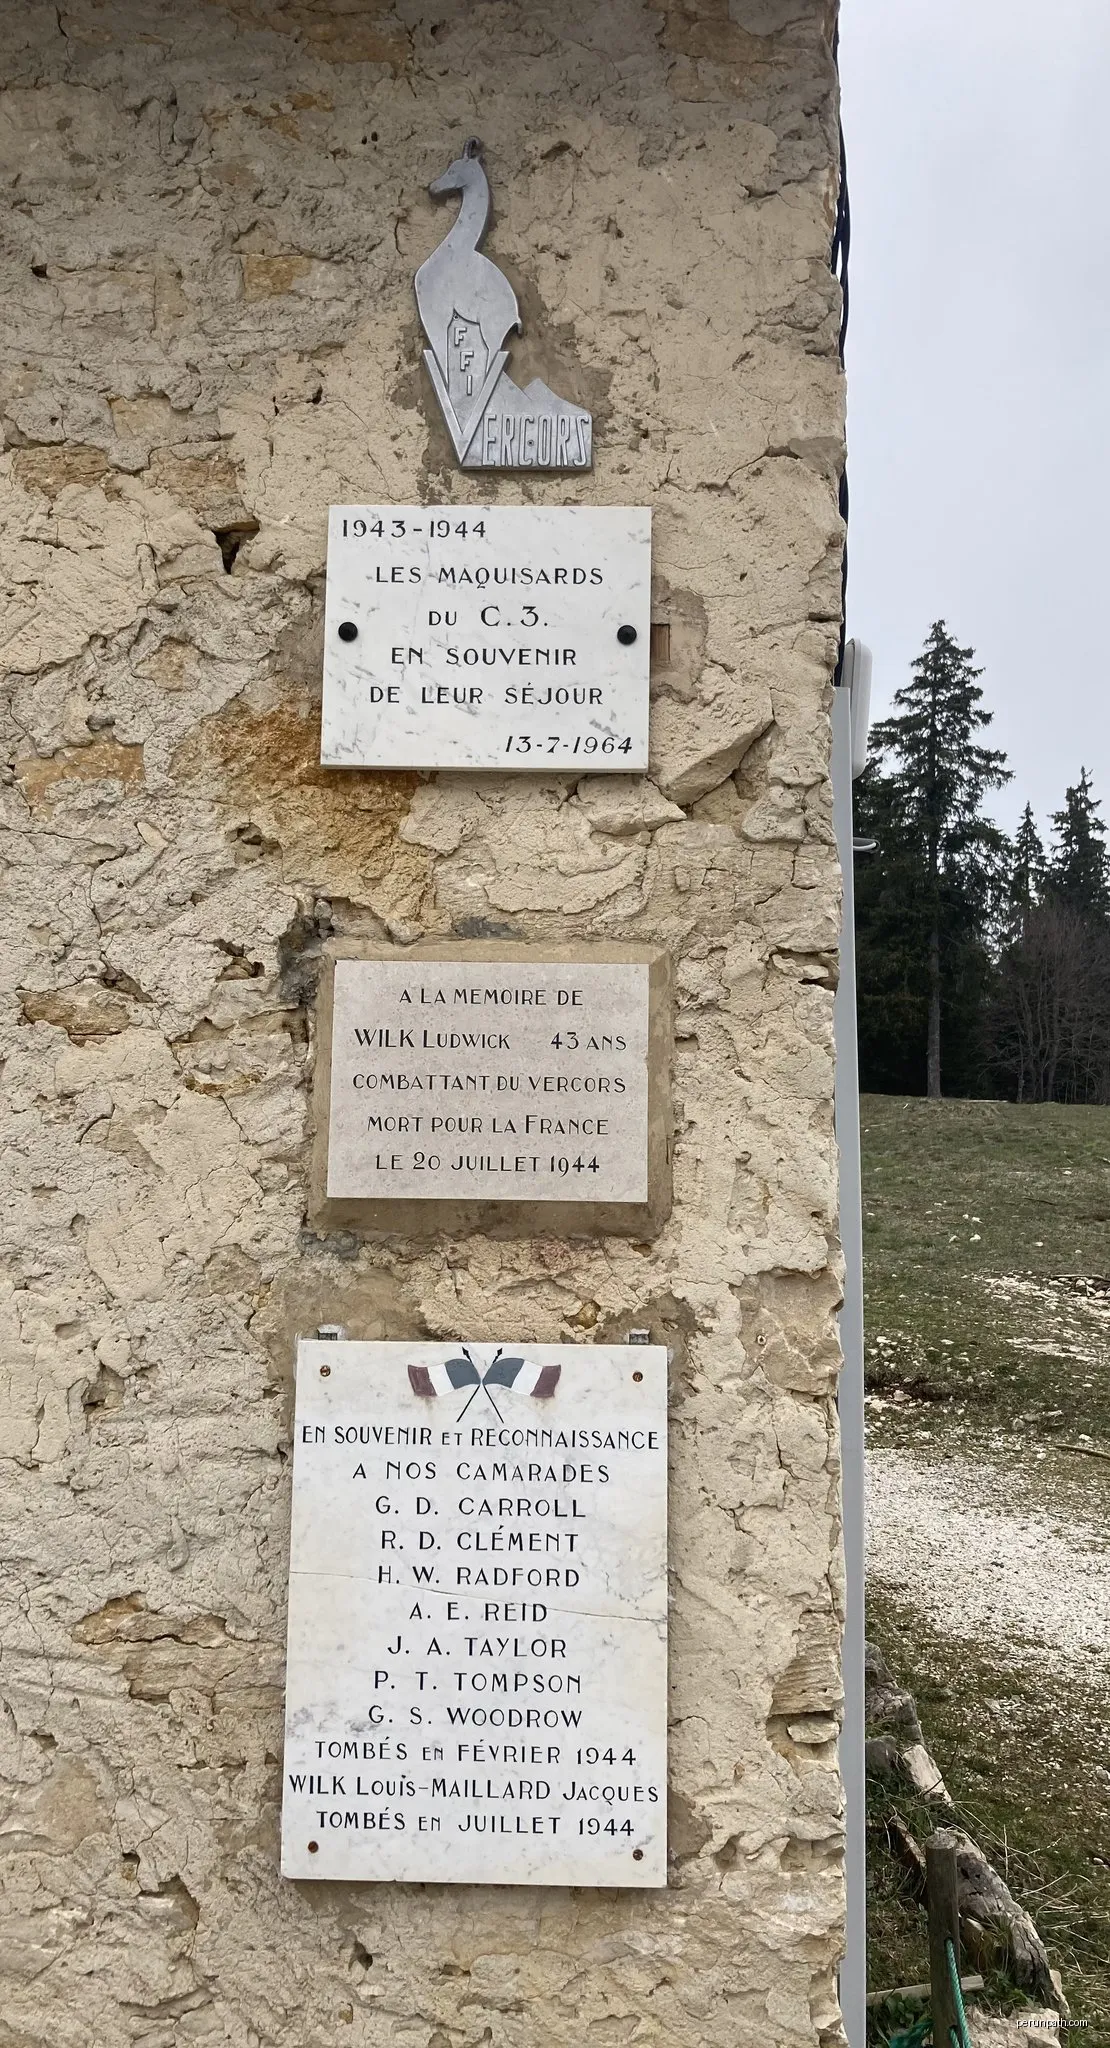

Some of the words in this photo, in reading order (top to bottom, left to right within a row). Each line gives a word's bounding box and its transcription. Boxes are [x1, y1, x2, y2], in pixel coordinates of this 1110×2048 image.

[342, 519, 487, 538] 1943-1944
[376, 566, 422, 583] LES
[438, 567, 604, 588] MAQUISARDS
[428, 610, 457, 626] DU
[391, 648, 423, 664] EN
[446, 648, 577, 665] SOUVENIR
[370, 686, 400, 703] DE
[421, 687, 483, 704] LEUR
[504, 682, 603, 705] SÉJOUR
[505, 736, 632, 754] 13-7-1964
[399, 989, 412, 1004] A
[420, 988, 446, 1004] LA
[453, 989, 546, 1006] MEMOIRE
[557, 990, 583, 1006] DE
[354, 1029, 415, 1048] WILK
[550, 1032, 579, 1050] 43
[586, 1034, 627, 1051] ANS
[352, 1074, 490, 1091] COMBATTANT
[497, 1076, 520, 1091] DU
[528, 1076, 626, 1093] VERCORS
[367, 1116, 423, 1133] MORT
[431, 1117, 482, 1133] POUR
[492, 1118, 516, 1133] LA
[376, 1154, 403, 1170] LE
[412, 1152, 441, 1171] 20
[451, 1155, 541, 1172] JUILLET
[550, 1155, 600, 1177] 1944
[302, 1425, 326, 1444] EN
[334, 1426, 432, 1446] SOUVENIR
[470, 1428, 659, 1450] RECONNAISSANCE
[352, 1463, 366, 1479] A
[386, 1462, 437, 1480] NOS
[456, 1462, 609, 1484] CAMARADES
[375, 1496, 399, 1514] G.
[416, 1497, 439, 1516] D.
[458, 1497, 586, 1518] CARROLL
[381, 1530, 403, 1550] R.
[419, 1531, 441, 1550] D.
[457, 1525, 579, 1552] CLÉMENT
[378, 1566, 400, 1584] H.
[412, 1567, 440, 1584] W.
[456, 1567, 580, 1587] RADFORD
[409, 1602, 431, 1620] A.
[447, 1602, 469, 1621] E.
[485, 1603, 548, 1622] REID
[387, 1636, 409, 1655] J.
[426, 1638, 450, 1656] A.
[464, 1638, 567, 1658] TAYLOR
[374, 1671, 395, 1689] P.
[415, 1672, 437, 1690] T.
[454, 1673, 581, 1694] TOMPSON
[368, 1705, 393, 1724] G.
[409, 1707, 432, 1725] S.
[447, 1707, 582, 1728] WOODROW
[315, 1736, 407, 1761] TOMBÉS
[458, 1740, 560, 1764] FÉVRIER
[576, 1748, 636, 1766] 1944
[289, 1774, 346, 1795] WILK
[317, 1807, 405, 1830] TOMBÉS
[458, 1815, 561, 1835] JUILLET
[578, 1818, 635, 1836] 1944
